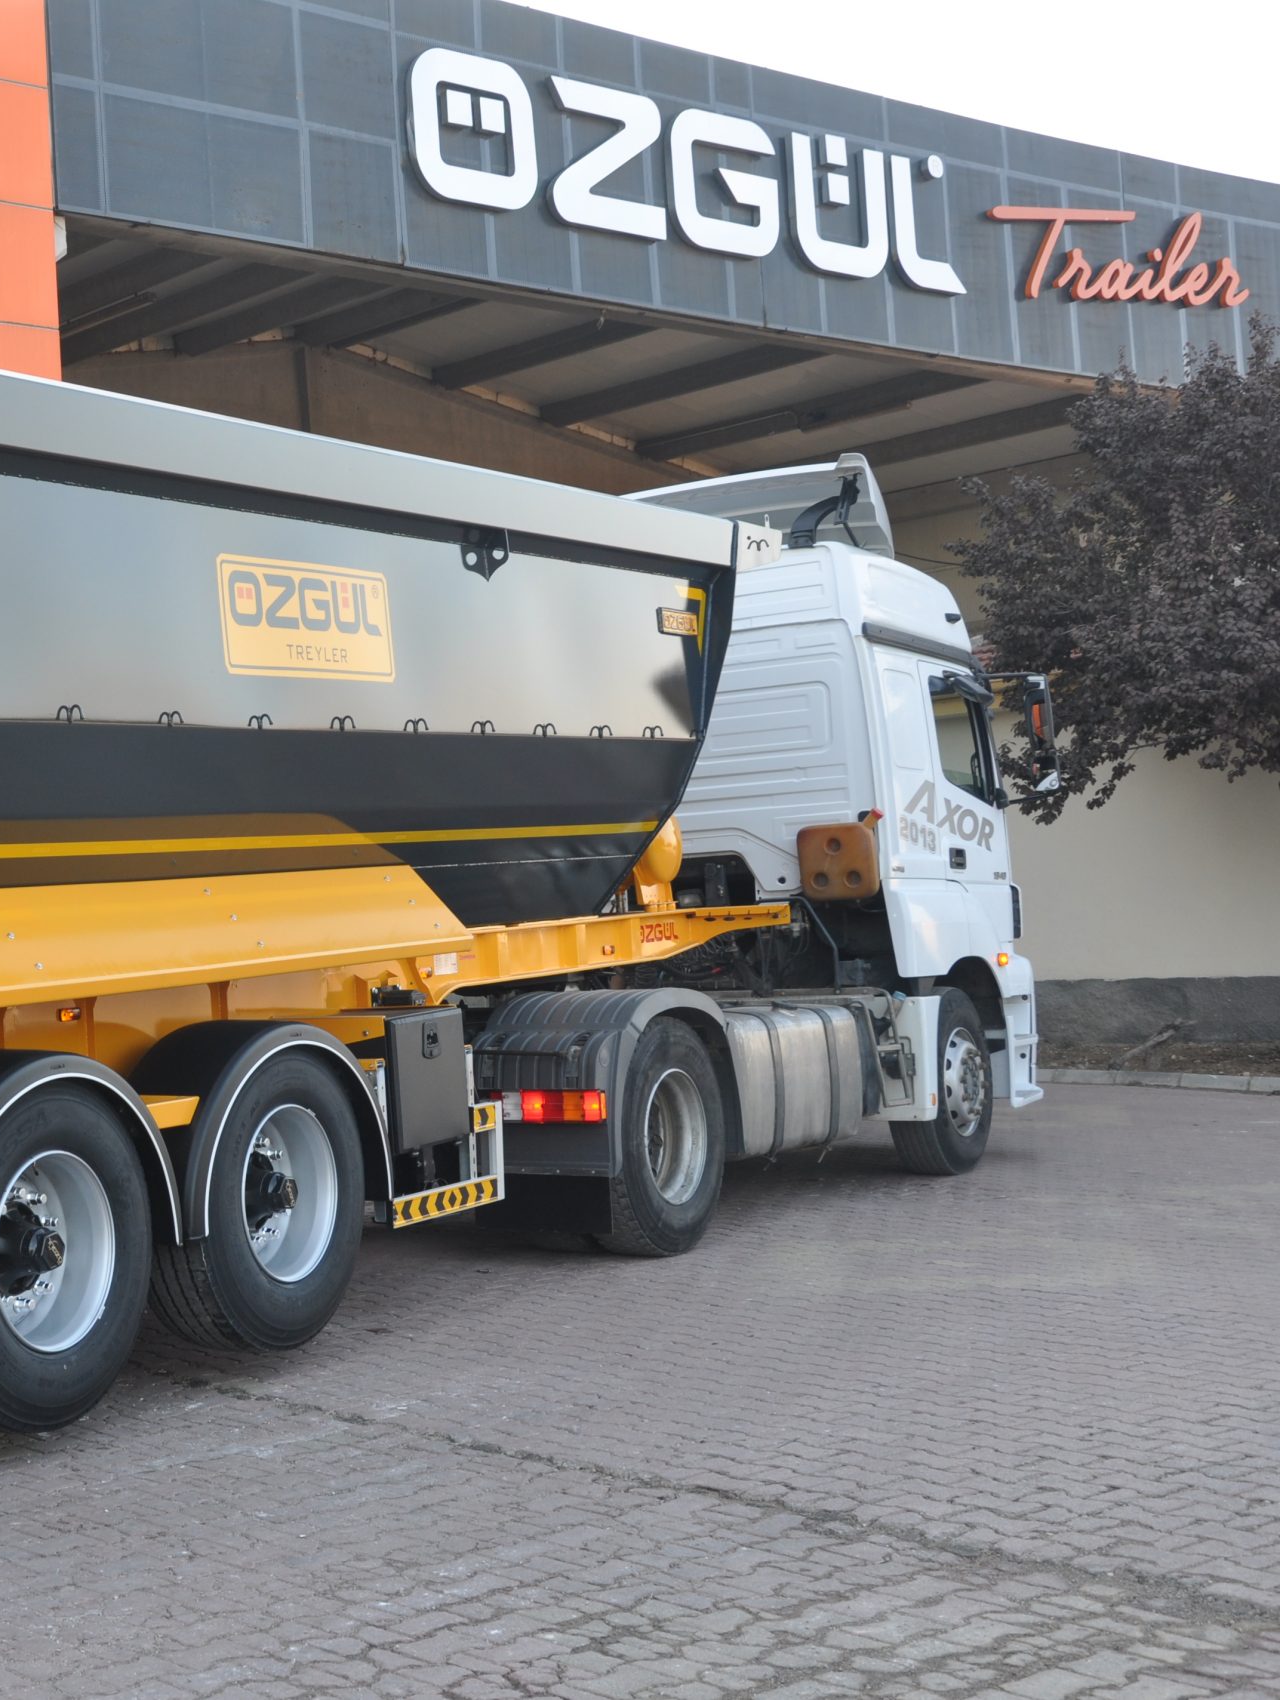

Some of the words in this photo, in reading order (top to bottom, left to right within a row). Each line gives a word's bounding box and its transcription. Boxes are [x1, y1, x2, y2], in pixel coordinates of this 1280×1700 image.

[407, 47, 967, 296] ÖZGÜL
[985, 205, 1251, 308] Trailer
[228, 569, 383, 637] ÖZGÜL
[286, 643, 349, 664] TREYLER
[903, 779, 995, 852] AXOR
